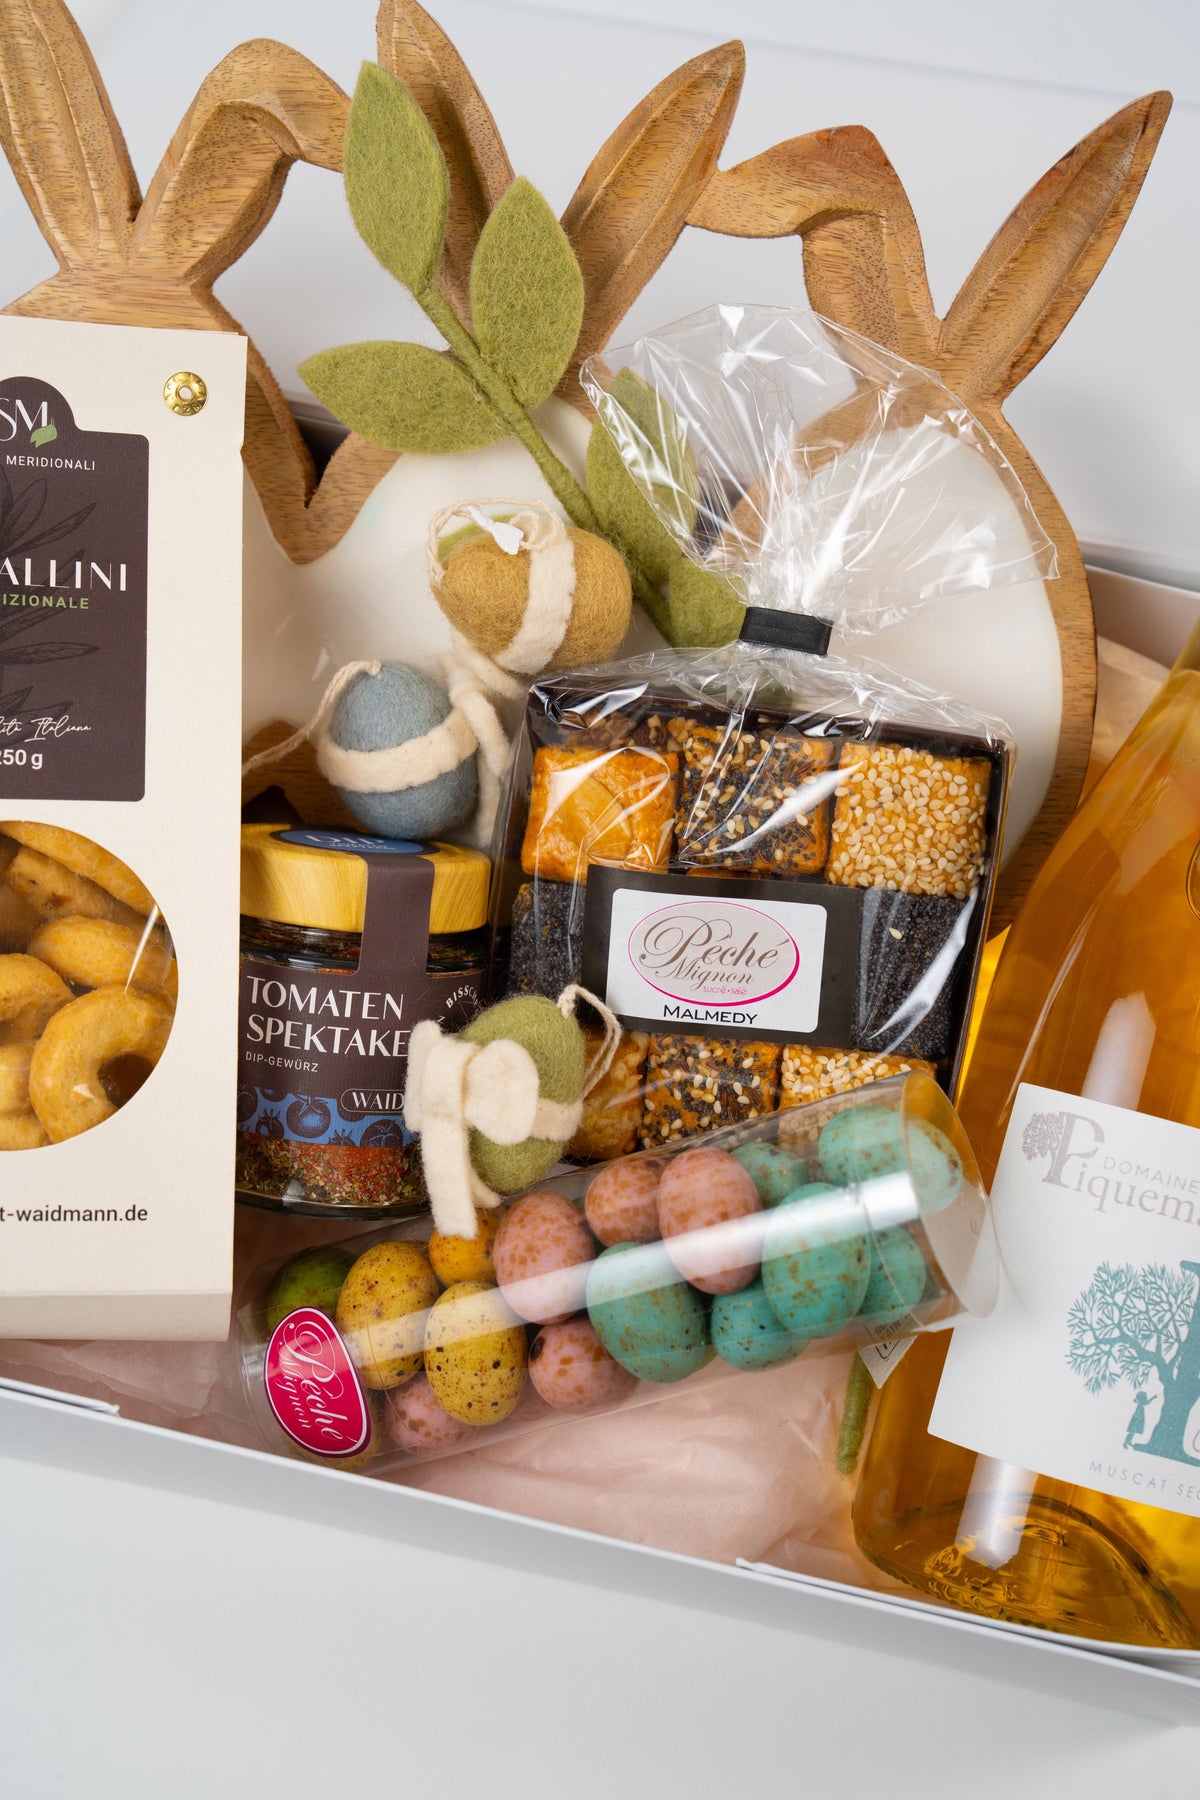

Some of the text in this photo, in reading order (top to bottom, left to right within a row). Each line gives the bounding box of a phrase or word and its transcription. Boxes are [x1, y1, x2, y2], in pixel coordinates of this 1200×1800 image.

[6, 455, 96, 471] MERIDIONALI
[0, 557, 127, 592] ALLINI
[2, 593, 89, 609] IZIONALE
[24, 715, 92, 743] Italiana
[0, 749, 43, 770] 50 g
[639, 915, 790, 970] Péché
[655, 955, 755, 991] Mignon
[246, 975, 404, 1020] TOMATEN
[663, 1004, 759, 1025] MALMEDY
[245, 1051, 320, 1073] DIP-GEWÜRZ
[351, 1091, 405, 1110] WAID
[1041, 1111, 1200, 1227] Piquem
[1103, 1156, 1200, 1194] DOMAINE
[0, 1204, 149, 1222] t-waidmann.de
[274, 1341, 312, 1429] Mignon
[282, 1320, 358, 1443] Péché
[1089, 1461, 1167, 1491] MUSCAT
